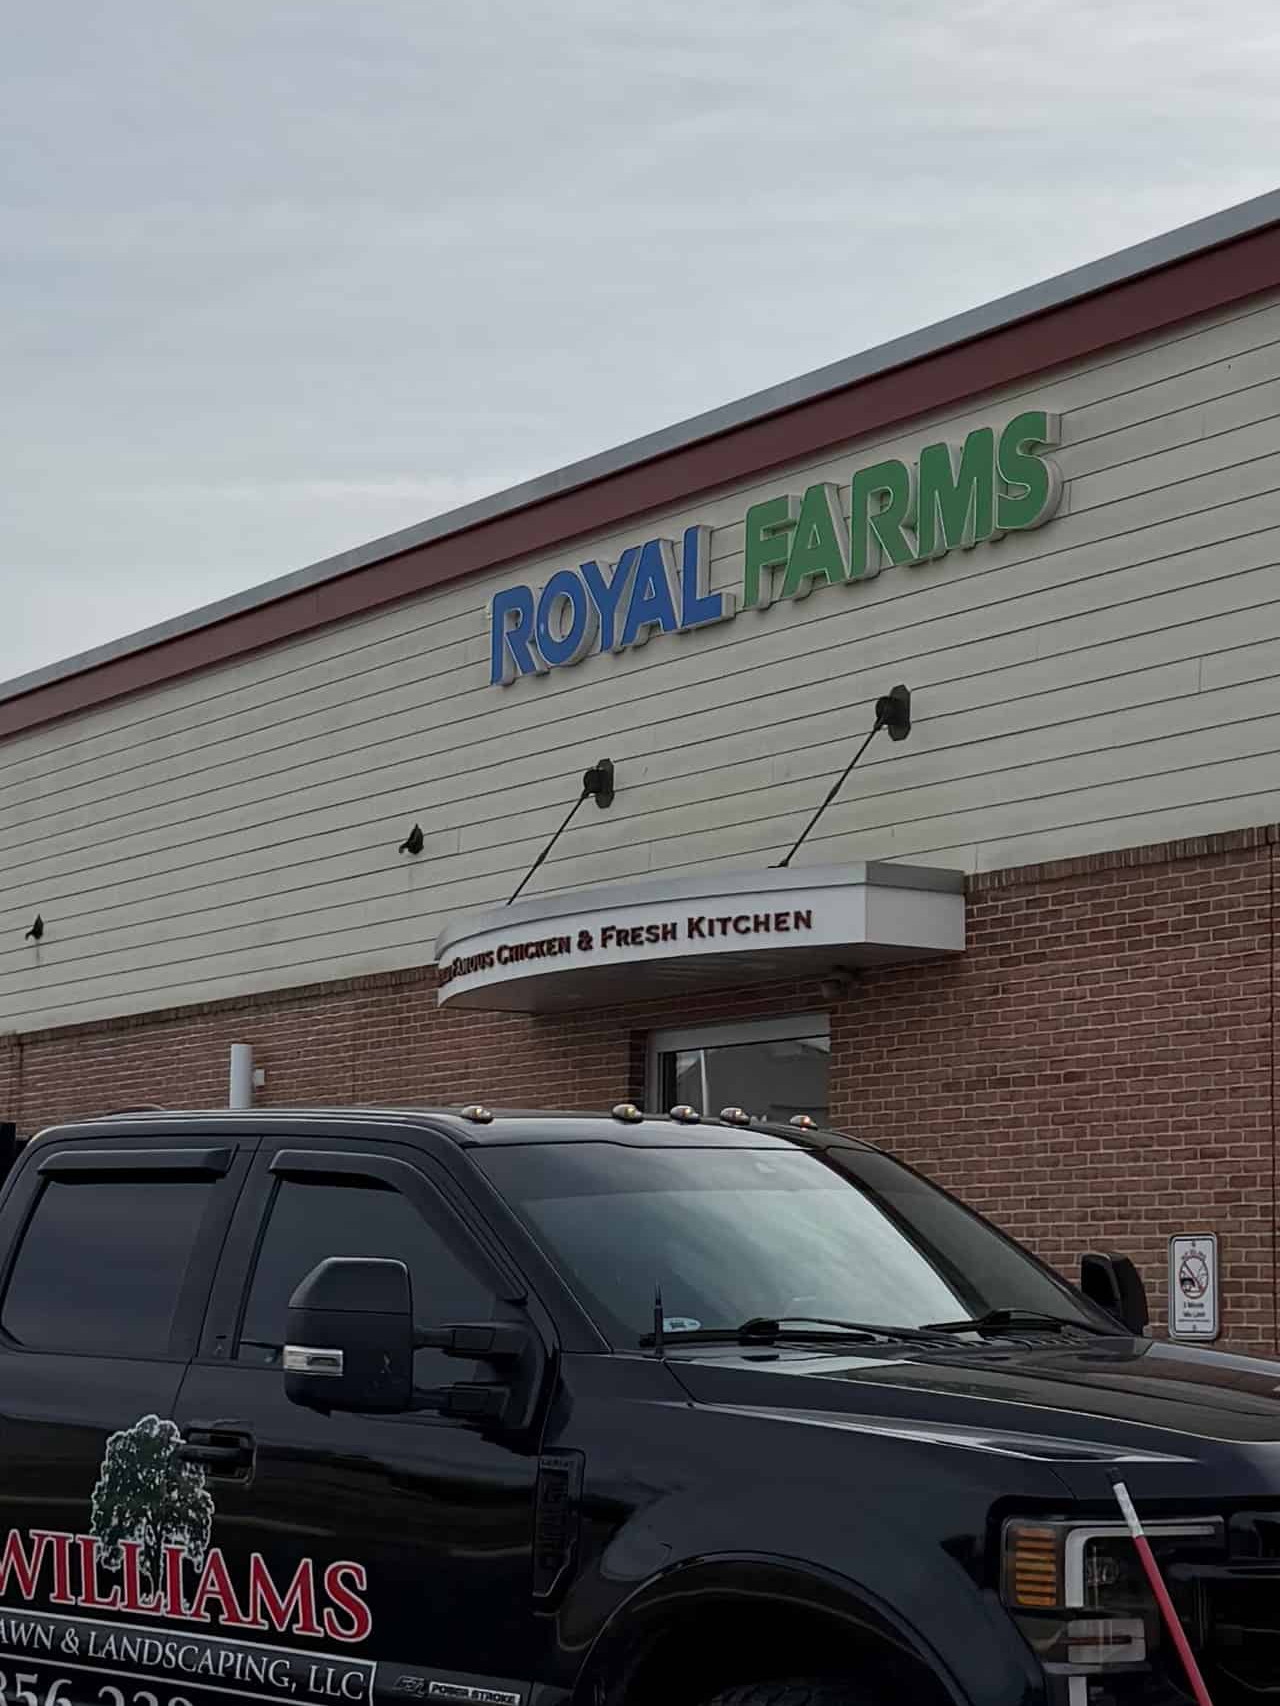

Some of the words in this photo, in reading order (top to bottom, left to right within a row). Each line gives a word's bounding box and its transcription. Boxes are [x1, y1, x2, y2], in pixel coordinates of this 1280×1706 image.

[490, 524, 732, 686] ROYAL
[743, 411, 1060, 609] FARMS
[496, 936, 571, 965] CHICKEN
[577, 930, 593, 951] &
[601, 923, 677, 949] FRESH
[687, 910, 813, 939] KITCHEN
[60, 1627, 80, 1655] &
[88, 1631, 297, 1693] LANDSCAPING,
[309, 1665, 365, 1701] LLC
